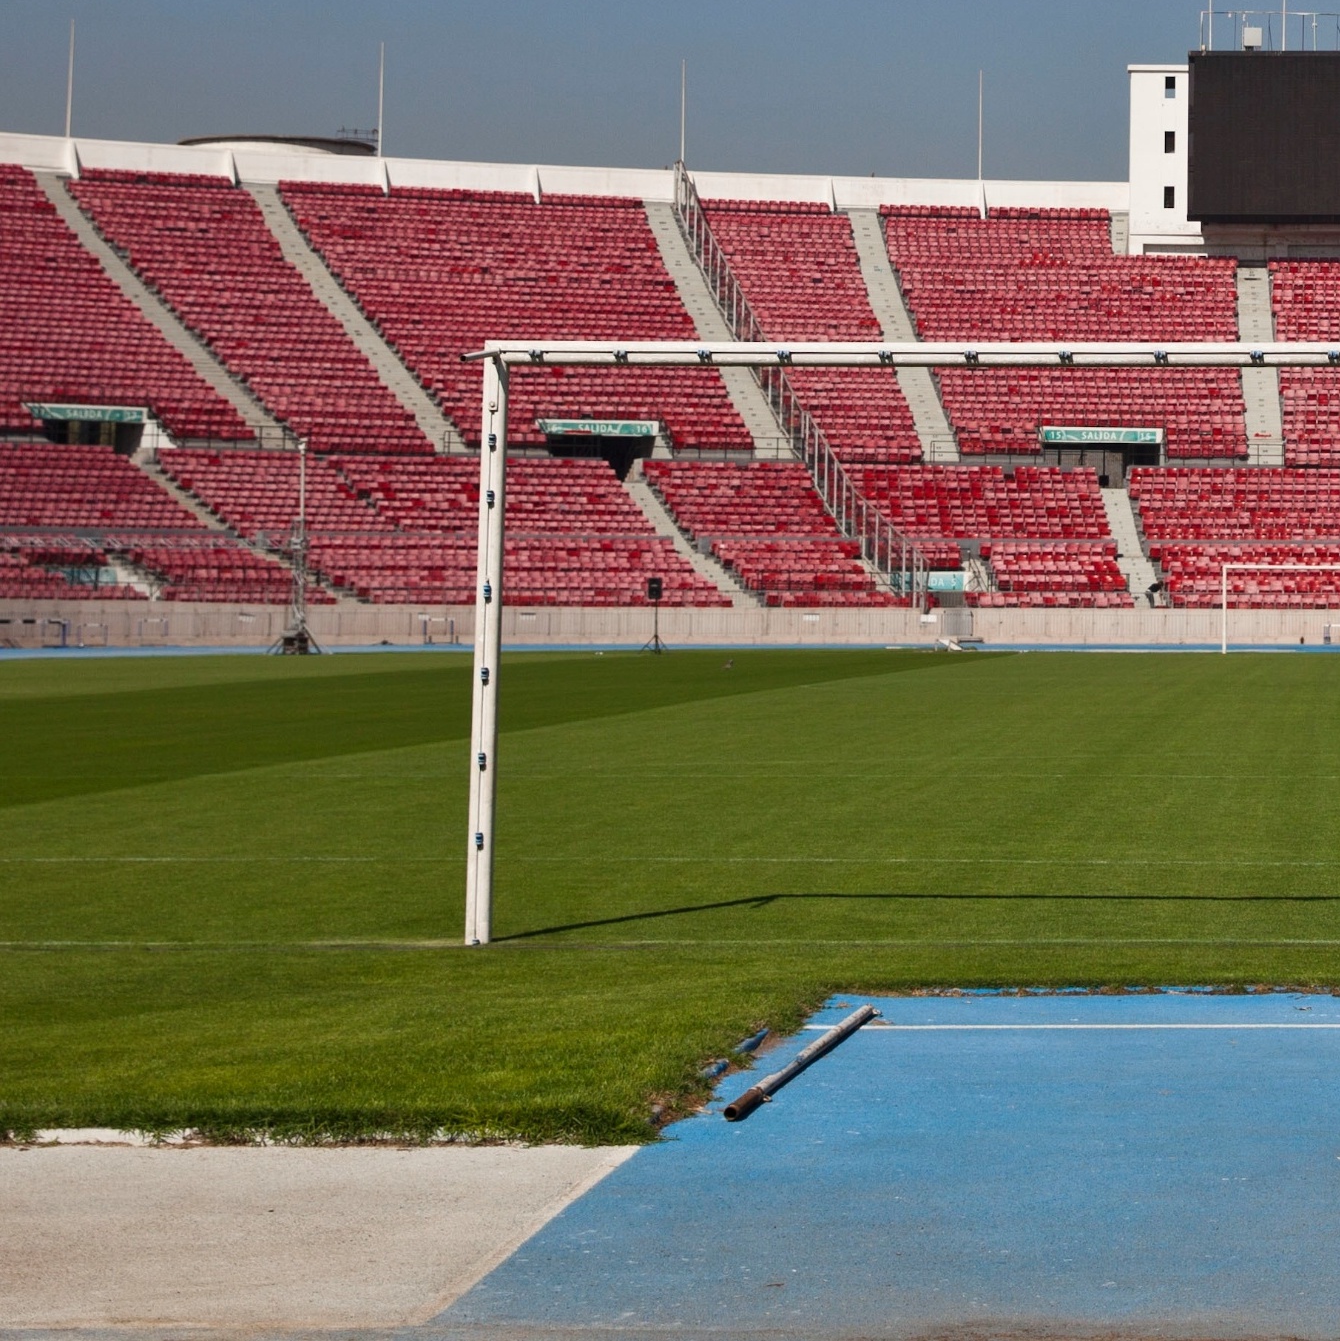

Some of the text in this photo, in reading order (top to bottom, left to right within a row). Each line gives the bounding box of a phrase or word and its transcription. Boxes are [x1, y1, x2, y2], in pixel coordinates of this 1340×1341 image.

[66, 409, 103, 419] SALIDA
[578, 424, 613, 434] SALIDA
[637, 425, 648, 434] 16
[1050, 431, 1061, 440] 15
[1081, 431, 1117, 440] SALIDA
